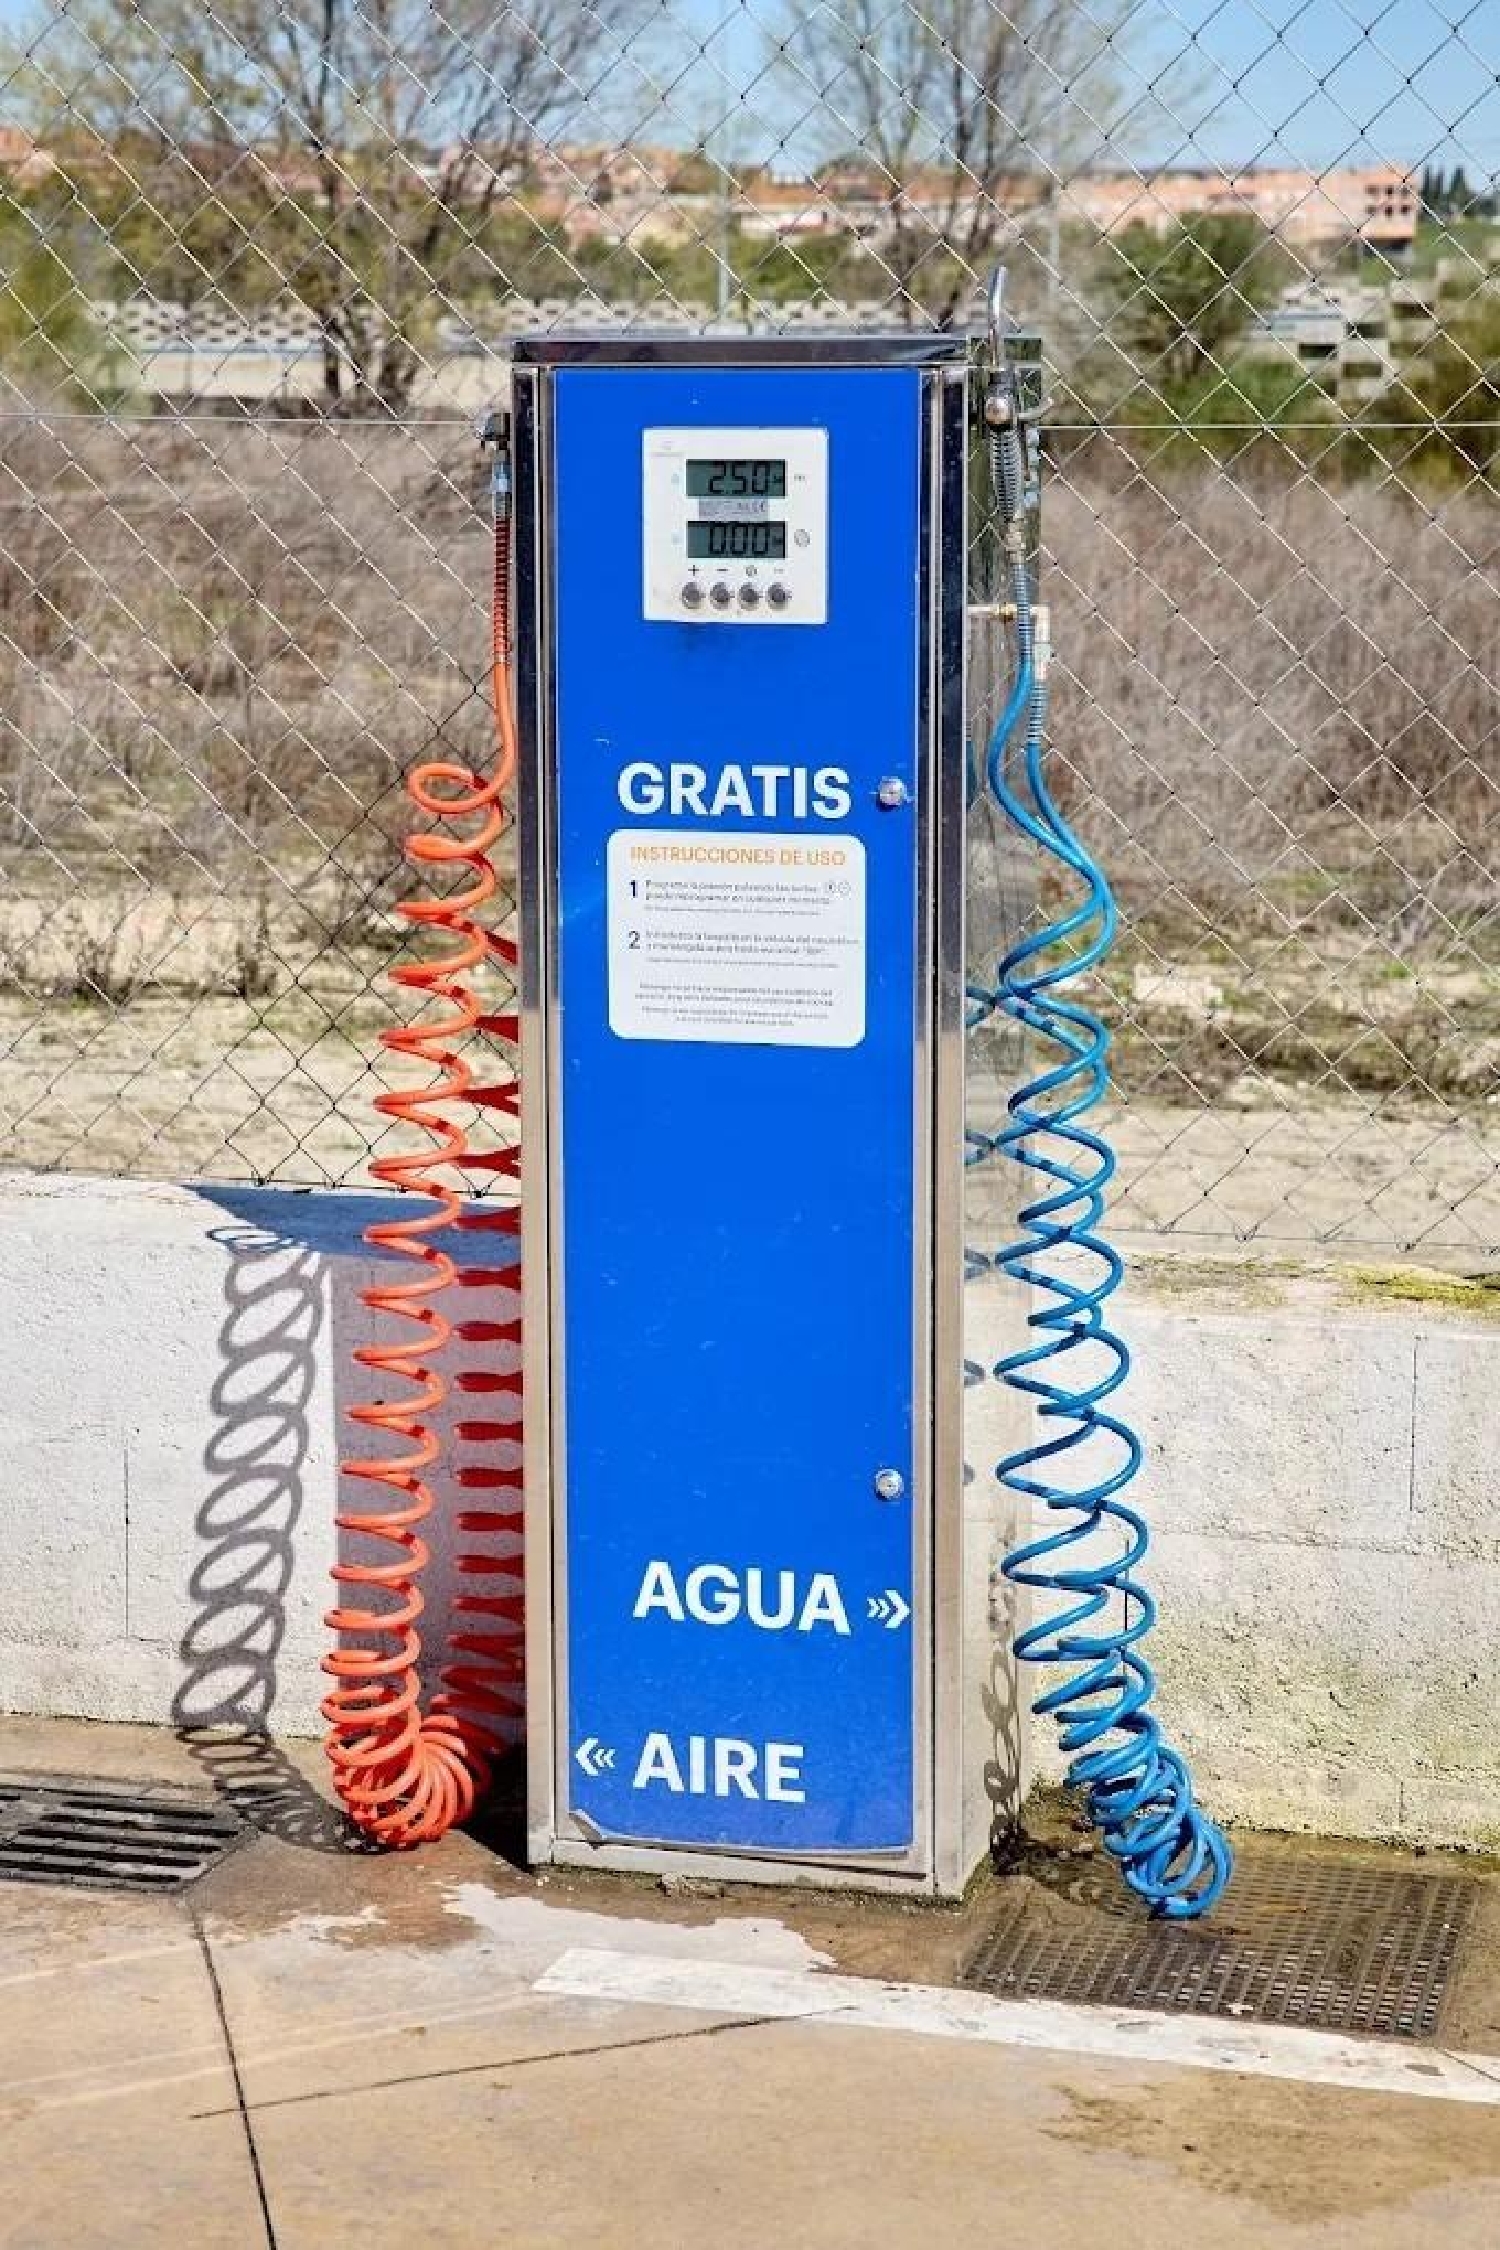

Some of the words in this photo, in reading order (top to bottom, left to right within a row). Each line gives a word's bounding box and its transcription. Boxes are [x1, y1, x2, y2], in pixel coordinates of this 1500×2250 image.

[617, 762, 851, 819] GRATIS
[630, 846, 775, 865] INSTRUCCIONES
[779, 849, 802, 865] DE
[806, 850, 846, 866] USO
[629, 880, 638, 899] 1
[628, 930, 641, 950] 2
[633, 1560, 851, 1635] AGUA
[633, 1731, 806, 1803] AIRE
